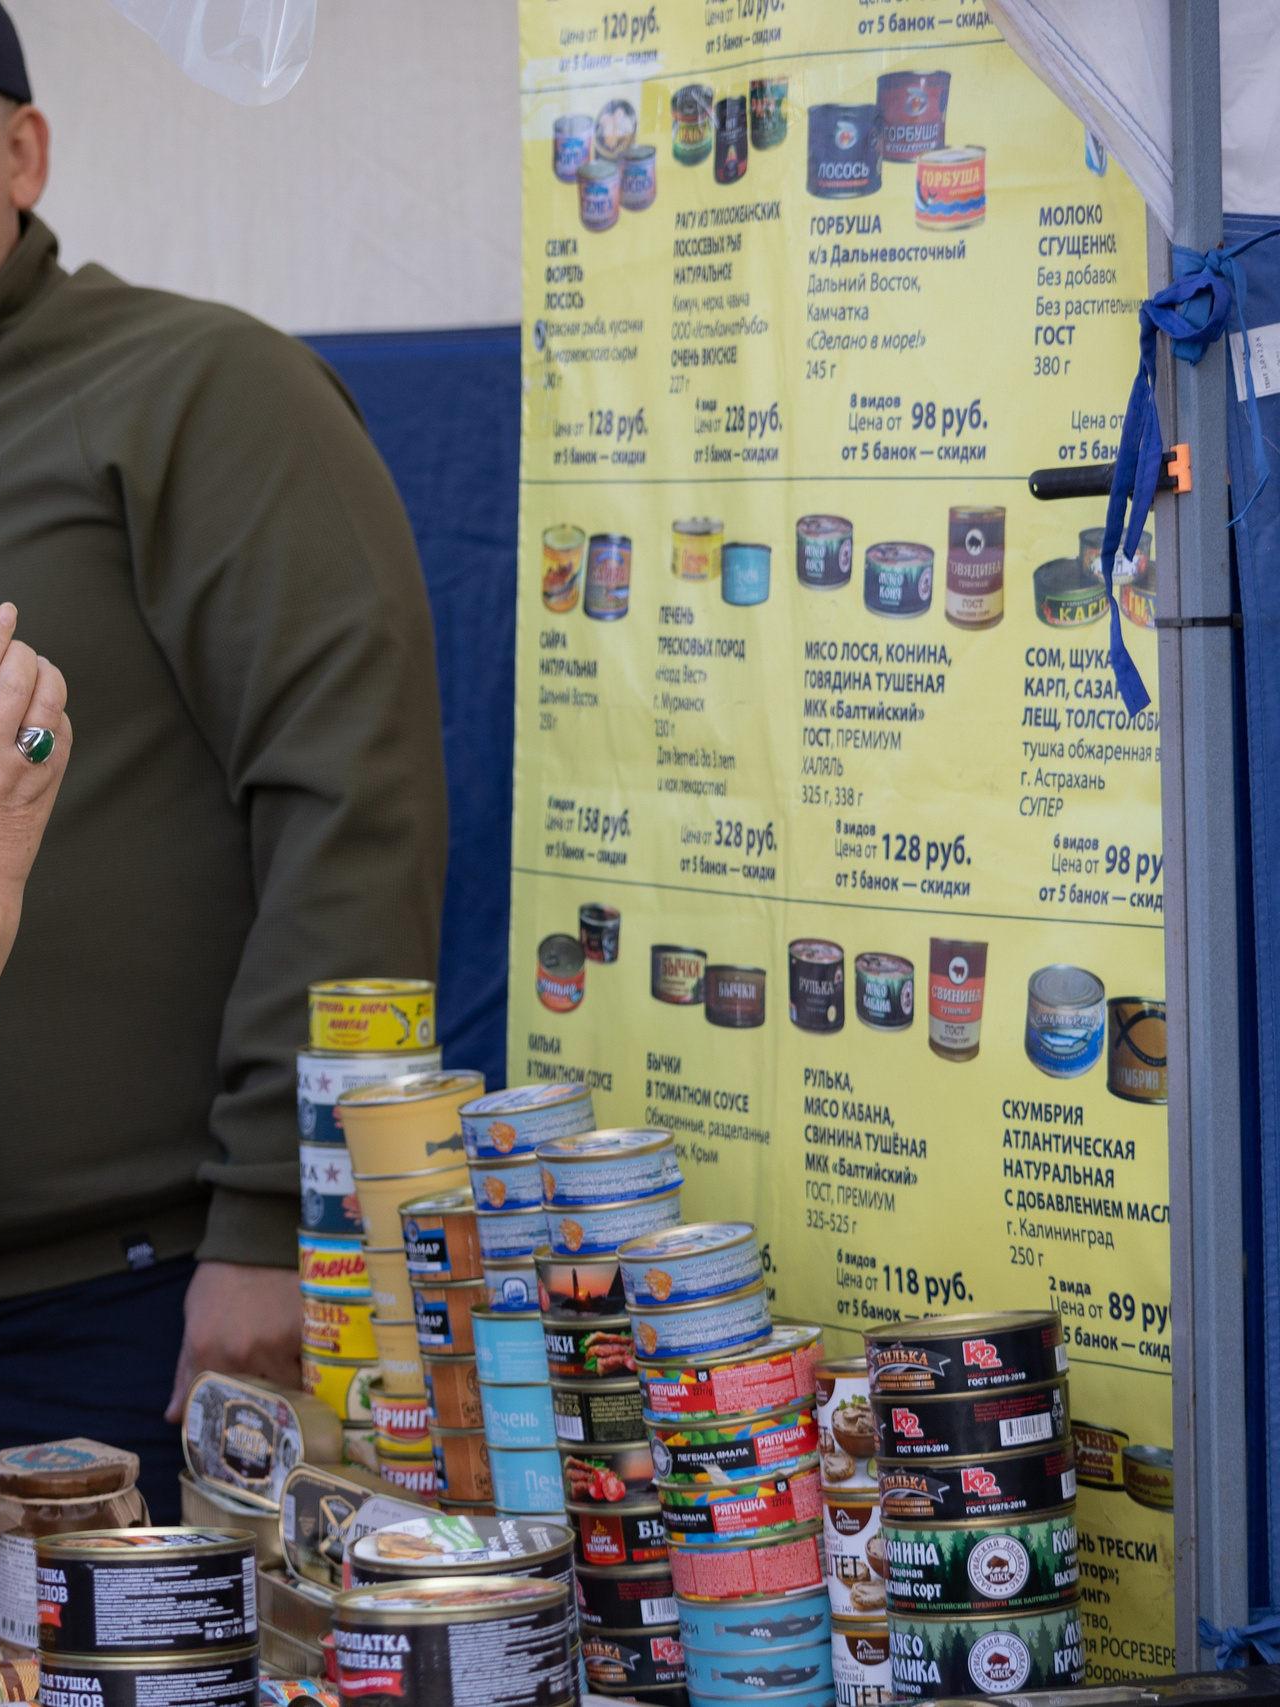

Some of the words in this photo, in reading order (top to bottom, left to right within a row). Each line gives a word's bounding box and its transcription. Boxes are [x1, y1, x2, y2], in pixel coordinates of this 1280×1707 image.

[602, 15, 628, 41] 120
[630, 7, 660, 44] руб.
[883, 123, 939, 142] ГОРБУША
[818, 162, 870, 180] ЛОСОСЬ
[921, 166, 981, 186] ГОРБУША
[810, 215, 882, 236] ГОРБУША
[1038, 204, 1103, 227] МОЛОКО
[809, 248, 827, 265] к/з
[830, 240, 966, 267] Дальневосточный
[807, 271, 867, 296] Дальний
[870, 269, 921, 294] Восток,
[1037, 265, 1062, 287] Без
[1065, 264, 1118, 290] добавок
[806, 304, 869, 322] Камчатка
[1035, 325, 1076, 347] ГОСТ
[1262, 372, 1271, 390] TENT
[725, 405, 746, 432] 228
[748, 402, 783, 439] руб.
[848, 412, 884, 433] Цена
[886, 416, 902, 431] от
[911, 401, 937, 430] 98
[942, 399, 989, 438] руб.
[841, 446, 859, 461] от
[861, 442, 870, 461] 5
[872, 441, 918, 461] банок
[937, 444, 987, 463] скидки
[949, 560, 1002, 579] ГОВЯДИНА
[659, 605, 695, 625] ПЕЧЕНЬ
[1058, 601, 1109, 624] КАРП
[804, 641, 838, 662] МЯСО
[840, 643, 882, 665] ЛОСЯ,
[886, 644, 953, 667] КОНИНА,
[804, 670, 872, 692] ГОВЯДИНА
[875, 672, 946, 694] ТУШЕНАЯ
[803, 699, 827, 719] МКК
[830, 700, 926, 723] «Балтийский»
[803, 727, 834, 749] ГОСТ,
[836, 729, 902, 751] ПРЕМИУМ
[802, 756, 844, 777] ХАЛЯЛЬ
[1020, 772, 1032, 788] г.
[1035, 767, 1106, 791] Астрахань
[1019, 797, 1064, 818] СУПЕР
[714, 820, 743, 848] 328
[746, 821, 777, 856] руб.
[1053, 834, 1061, 850] 6
[1063, 836, 1100, 852] видов
[834, 838, 862, 859] Цена
[864, 842, 878, 859] от
[882, 833, 921, 862] 128
[926, 835, 972, 872] руб.
[680, 858, 690, 873] от
[692, 856, 698, 873] 5
[699, 857, 727, 876] банок
[742, 863, 776, 884] скидки
[1051, 853, 1082, 875] Цена
[1084, 858, 1100, 874] от
[1105, 845, 1131, 875] 98
[1135, 853, 1164, 885] ру
[835, 872, 849, 888] от
[851, 870, 858, 888] 5
[859, 870, 900, 891] банок
[920, 876, 971, 899] скидки
[1039, 884, 1056, 902] от
[1058, 884, 1067, 903] 5
[1067, 884, 1109, 905] банок
[1129, 892, 1164, 913] скид
[718, 981, 757, 1000] БЫЧКИ
[930, 985, 982, 1004] СВИНИНА
[944, 1023, 966, 1037] ГОСТ
[647, 1052, 682, 1075] БЫЧКИ
[804, 1067, 854, 1094] РУЛЬКА,
[646, 1079, 653, 1098] В
[655, 1082, 712, 1108] ТОМАТНОМ
[714, 1090, 750, 1113] СОУСЕ
[804, 1096, 839, 1118] МЯСО
[842, 1100, 896, 1128] КАБАНА,
[1002, 1099, 1084, 1126] СКУМБРИЯ
[708, 1120, 771, 1146] разделанные
[804, 1125, 862, 1149] СВИНИНА
[865, 1130, 927, 1159] ТУШЁНАЯ
[1002, 1129, 1136, 1160] АТЛАНТИЧЕСКАЯ
[805, 1152, 829, 1175] МКК
[832, 1157, 918, 1186] «Балтийский»
[1003, 1158, 1116, 1188] НАТУРАЛЬНАЯ
[805, 1180, 835, 1205] ГОСТ,
[837, 1186, 896, 1213] ПРЕМИУМ
[1007, 1220, 1018, 1237] г.
[1020, 1222, 1116, 1250] Калининград
[836, 1267, 863, 1292] Цена
[865, 1275, 878, 1292] от
[883, 1265, 919, 1295] 118
[925, 1271, 974, 1305] руб.
[1048, 1276, 1057, 1292] 2
[1059, 1279, 1092, 1296] вида
[837, 1301, 851, 1316] от
[852, 1299, 860, 1316] 5
[862, 1301, 902, 1323] банок
[1050, 1295, 1085, 1319] Цена
[1088, 1304, 1104, 1320] от
[1108, 1292, 1136, 1322] 89
[876, 1350, 929, 1367] КИЛЬКА
[649, 1384, 689, 1397] РЯПУШКА
[967, 1376, 988, 1387] ГОСТ
[485, 1403, 539, 1428] Печень
[756, 1426, 806, 1449] РЯПУШКА
[896, 1444, 911, 1454] ГОСТ
[677, 1451, 716, 1462] ЛЕГЕНДА
[716, 1447, 749, 1459] ЯМАЛА
[883, 1475, 929, 1493] КИЛЬКА
[713, 1498, 767, 1516] РЯПУШКА
[966, 1505, 987, 1515] ГОСТ
[590, 1534, 612, 1545] ПОРТ
[1097, 1535, 1158, 1563] ТРЕСКИ
[989, 1573, 1011, 1582] МКК
[989, 1668, 1011, 1678] МКК
